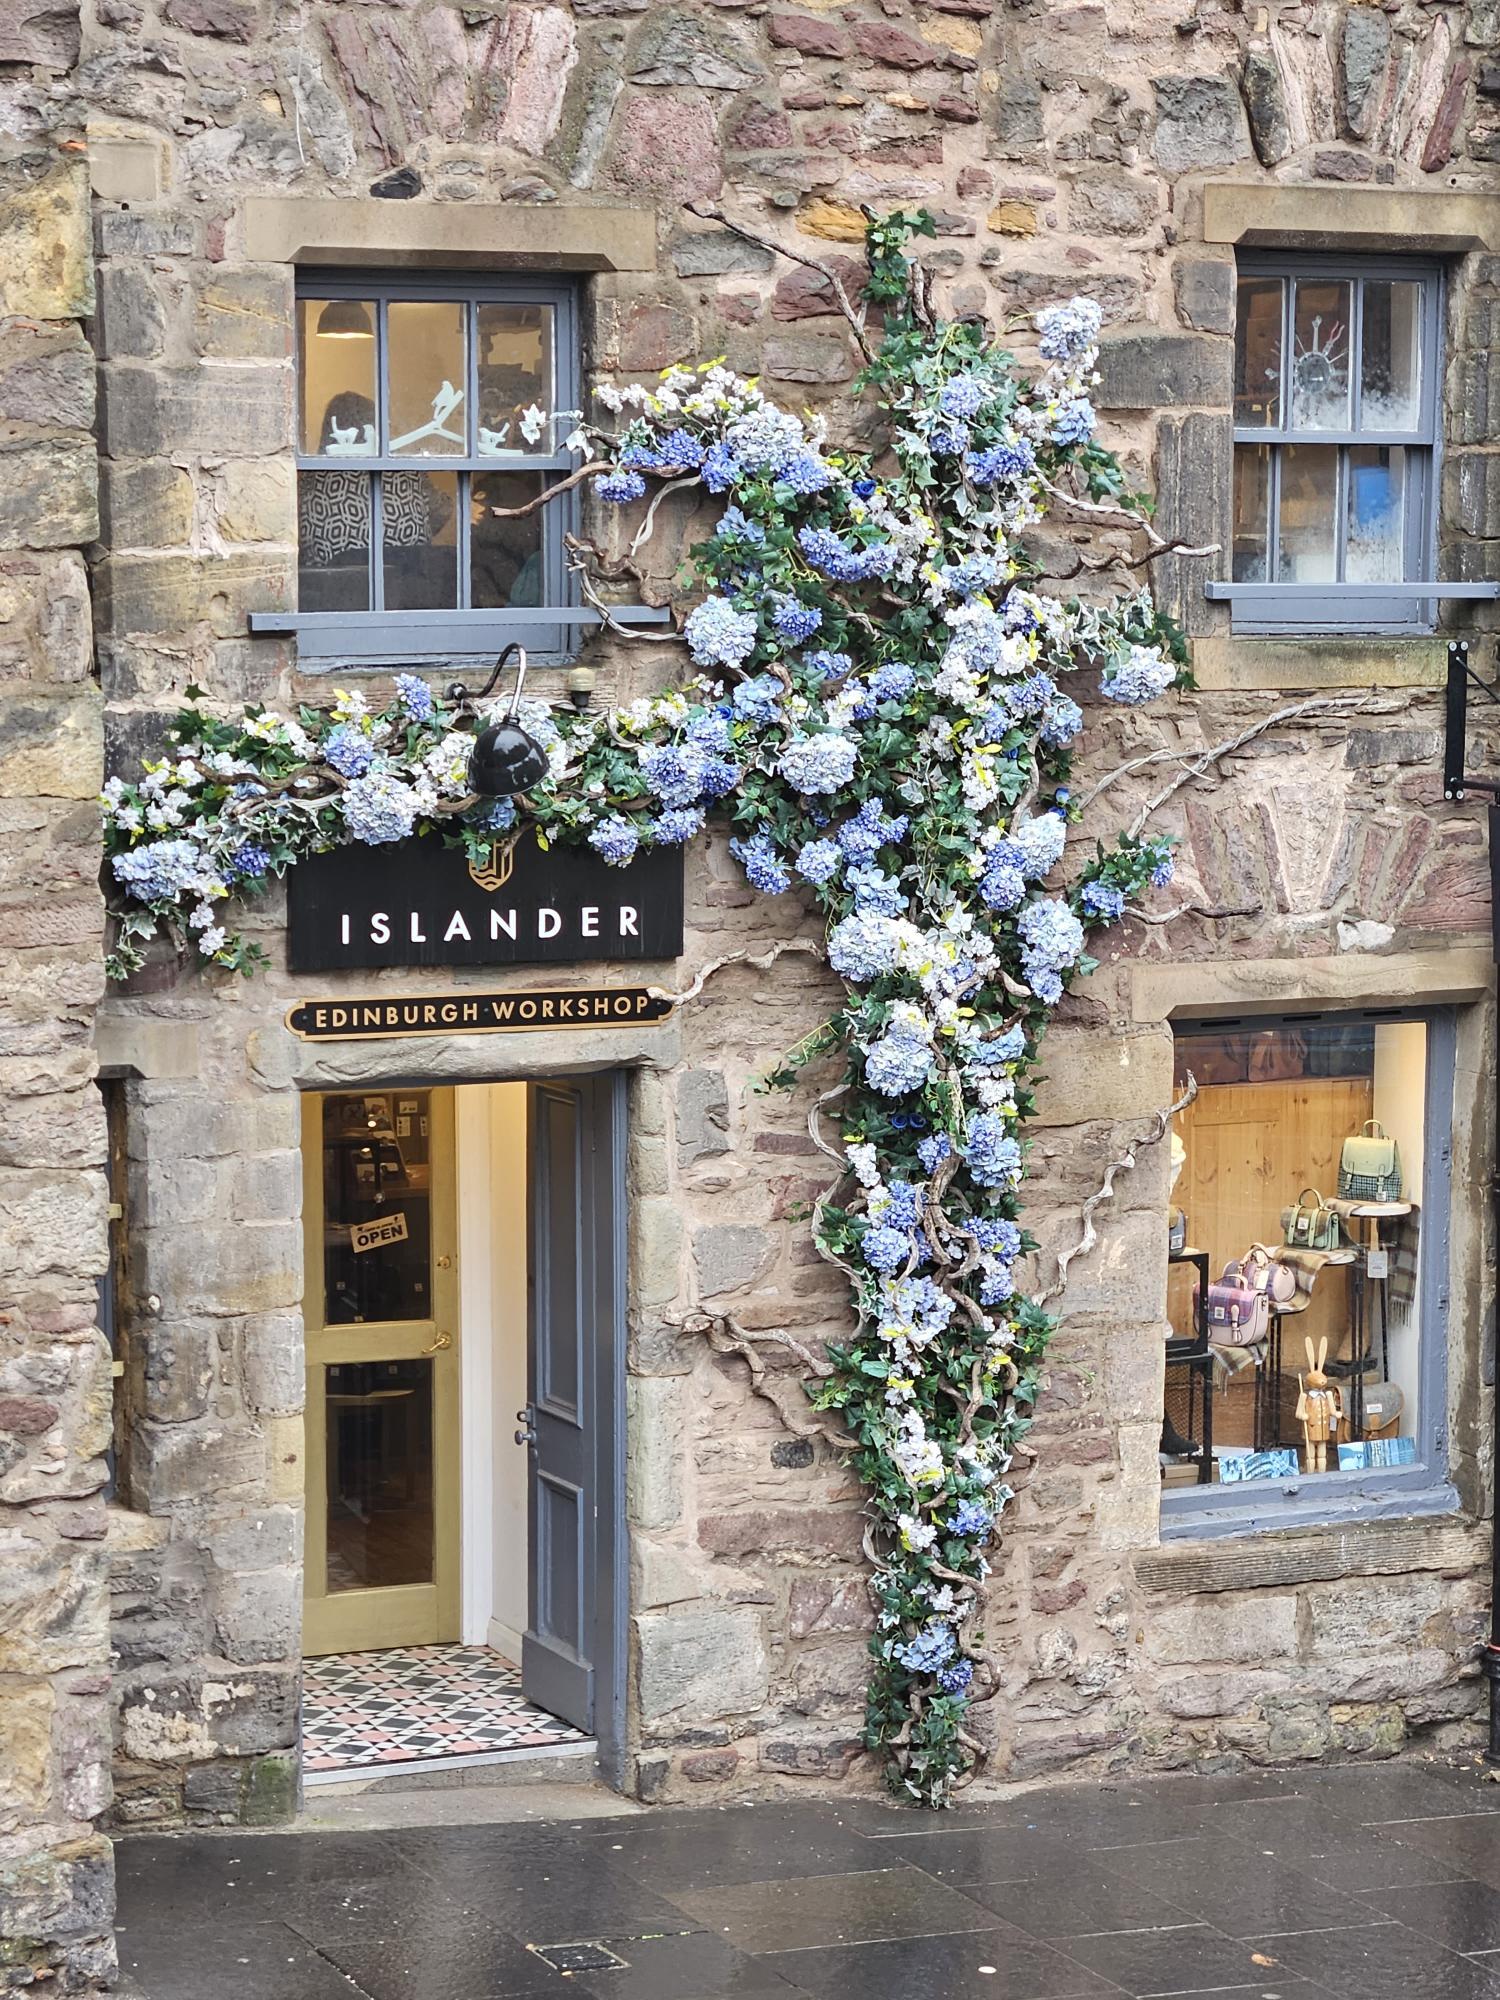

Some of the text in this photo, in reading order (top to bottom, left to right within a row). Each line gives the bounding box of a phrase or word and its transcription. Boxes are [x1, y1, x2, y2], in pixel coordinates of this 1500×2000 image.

[341, 906, 639, 945] ISLANDER
[315, 996, 648, 1028] EDINBURGH WORKSHOP
[357, 1224, 403, 1246] OPEN
